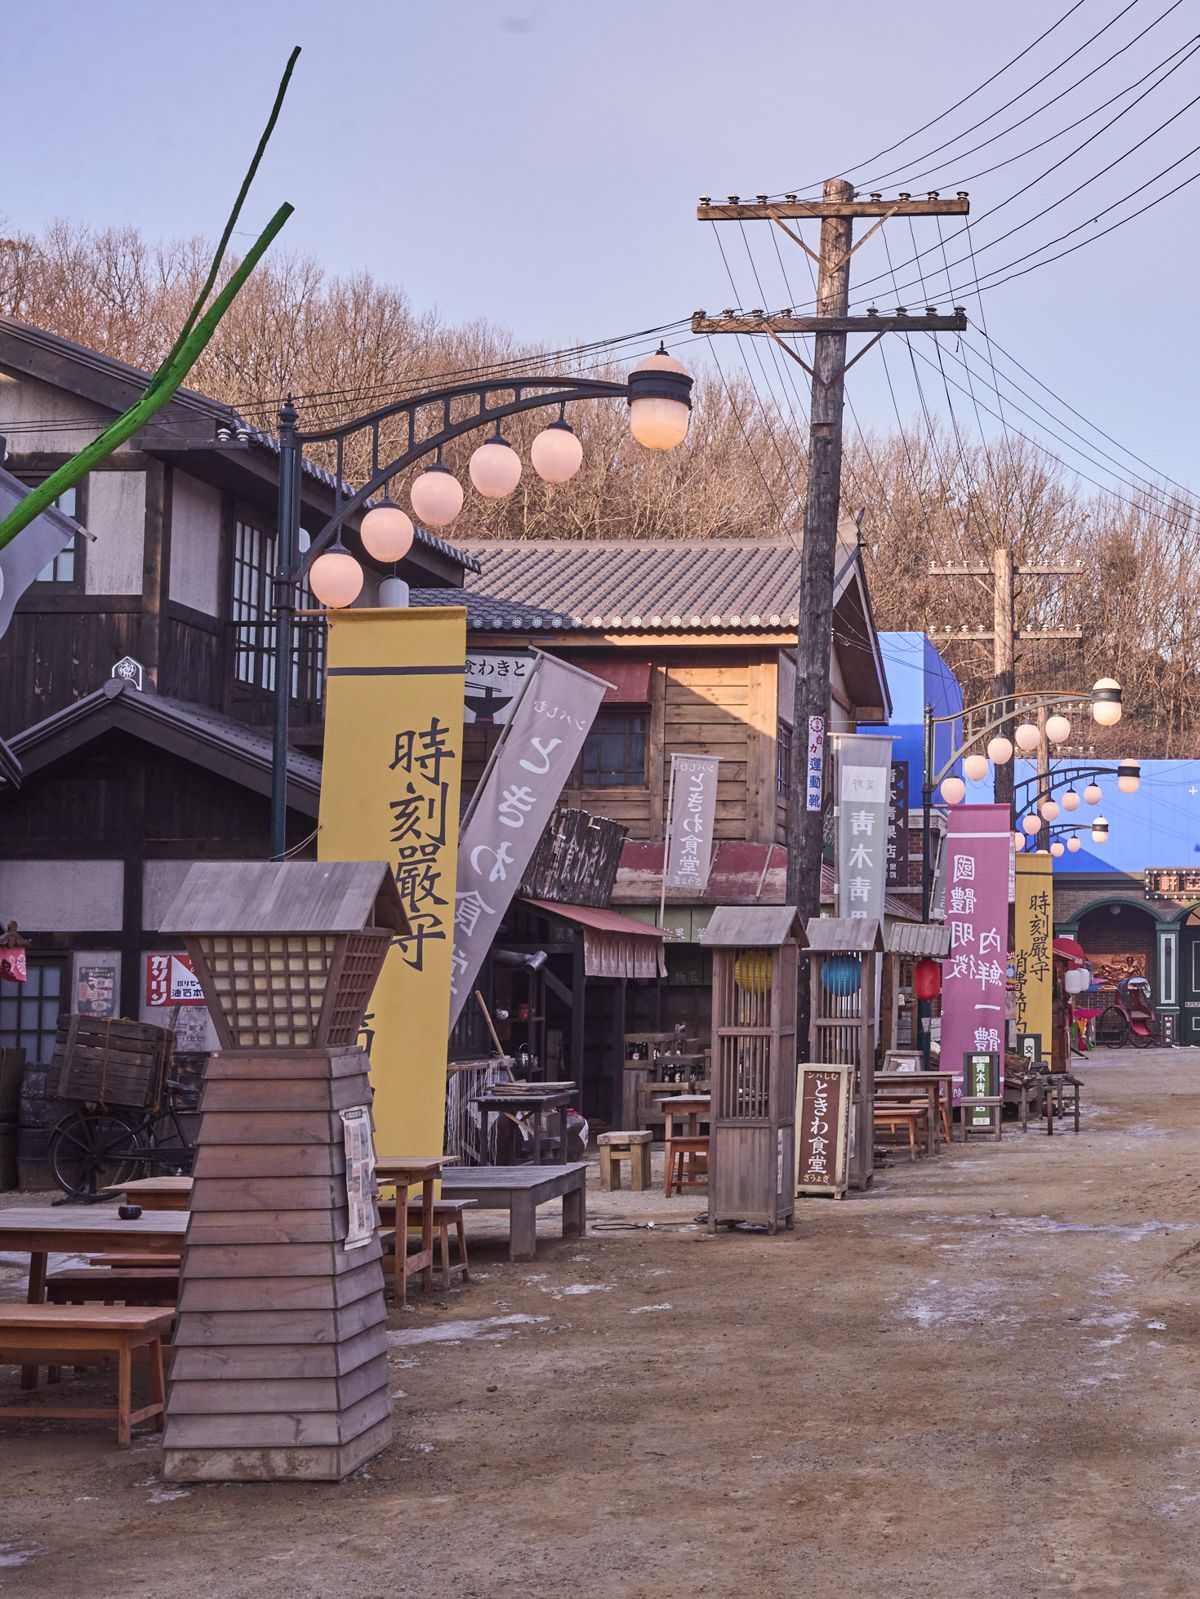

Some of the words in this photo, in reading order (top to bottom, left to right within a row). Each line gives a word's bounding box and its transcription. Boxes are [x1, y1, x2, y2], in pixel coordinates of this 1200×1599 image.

[151, 956, 170, 1005] ガソリン
[807, 1079, 829, 1175] ときわ食堂
